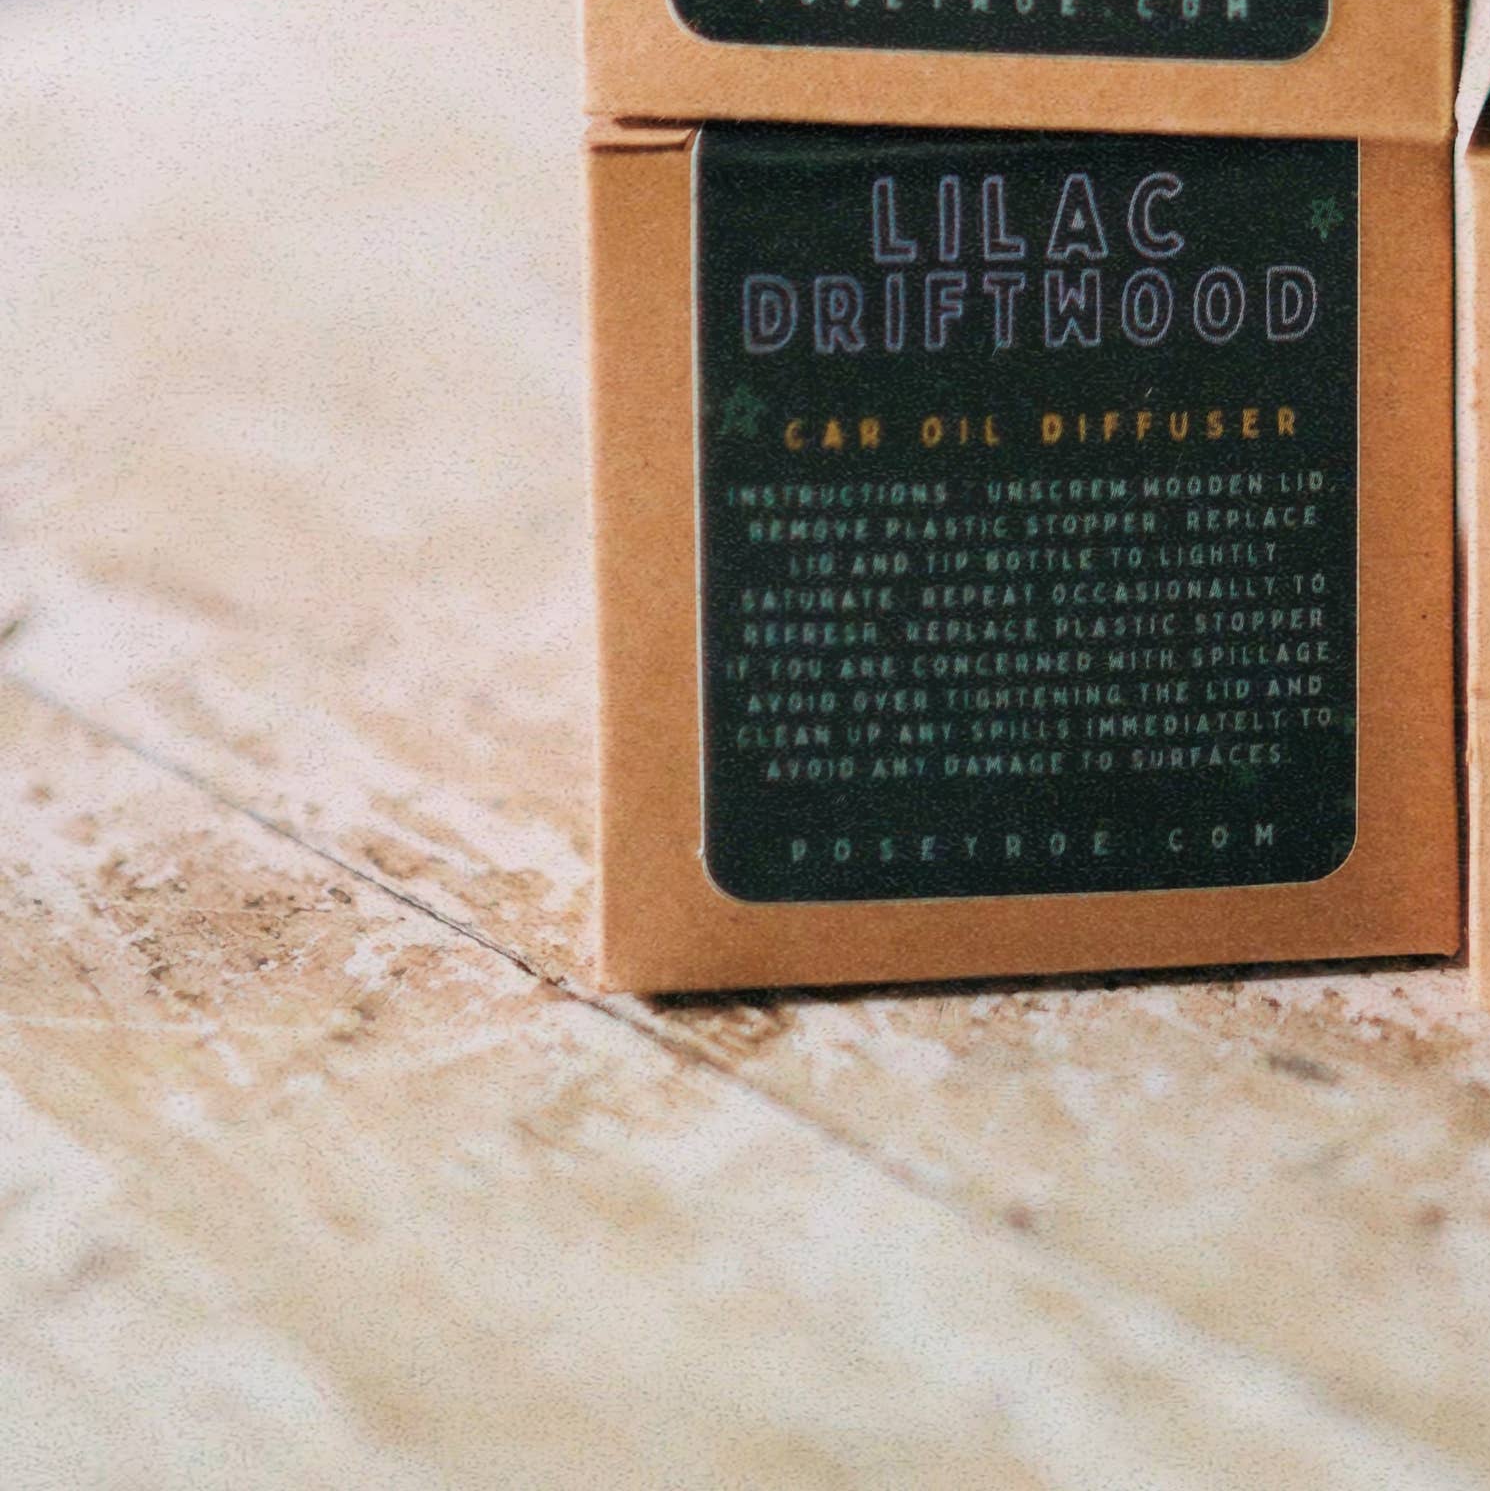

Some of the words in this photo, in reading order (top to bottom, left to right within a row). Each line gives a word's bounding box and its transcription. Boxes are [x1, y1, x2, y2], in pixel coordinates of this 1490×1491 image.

[870, 170, 1187, 264] LILAC
[741, 262, 1319, 358] DRIFTWOOD
[784, 417, 881, 450] CAR
[920, 415, 1000, 447] OIL
[1040, 406, 1296, 444] DIFFUSER
